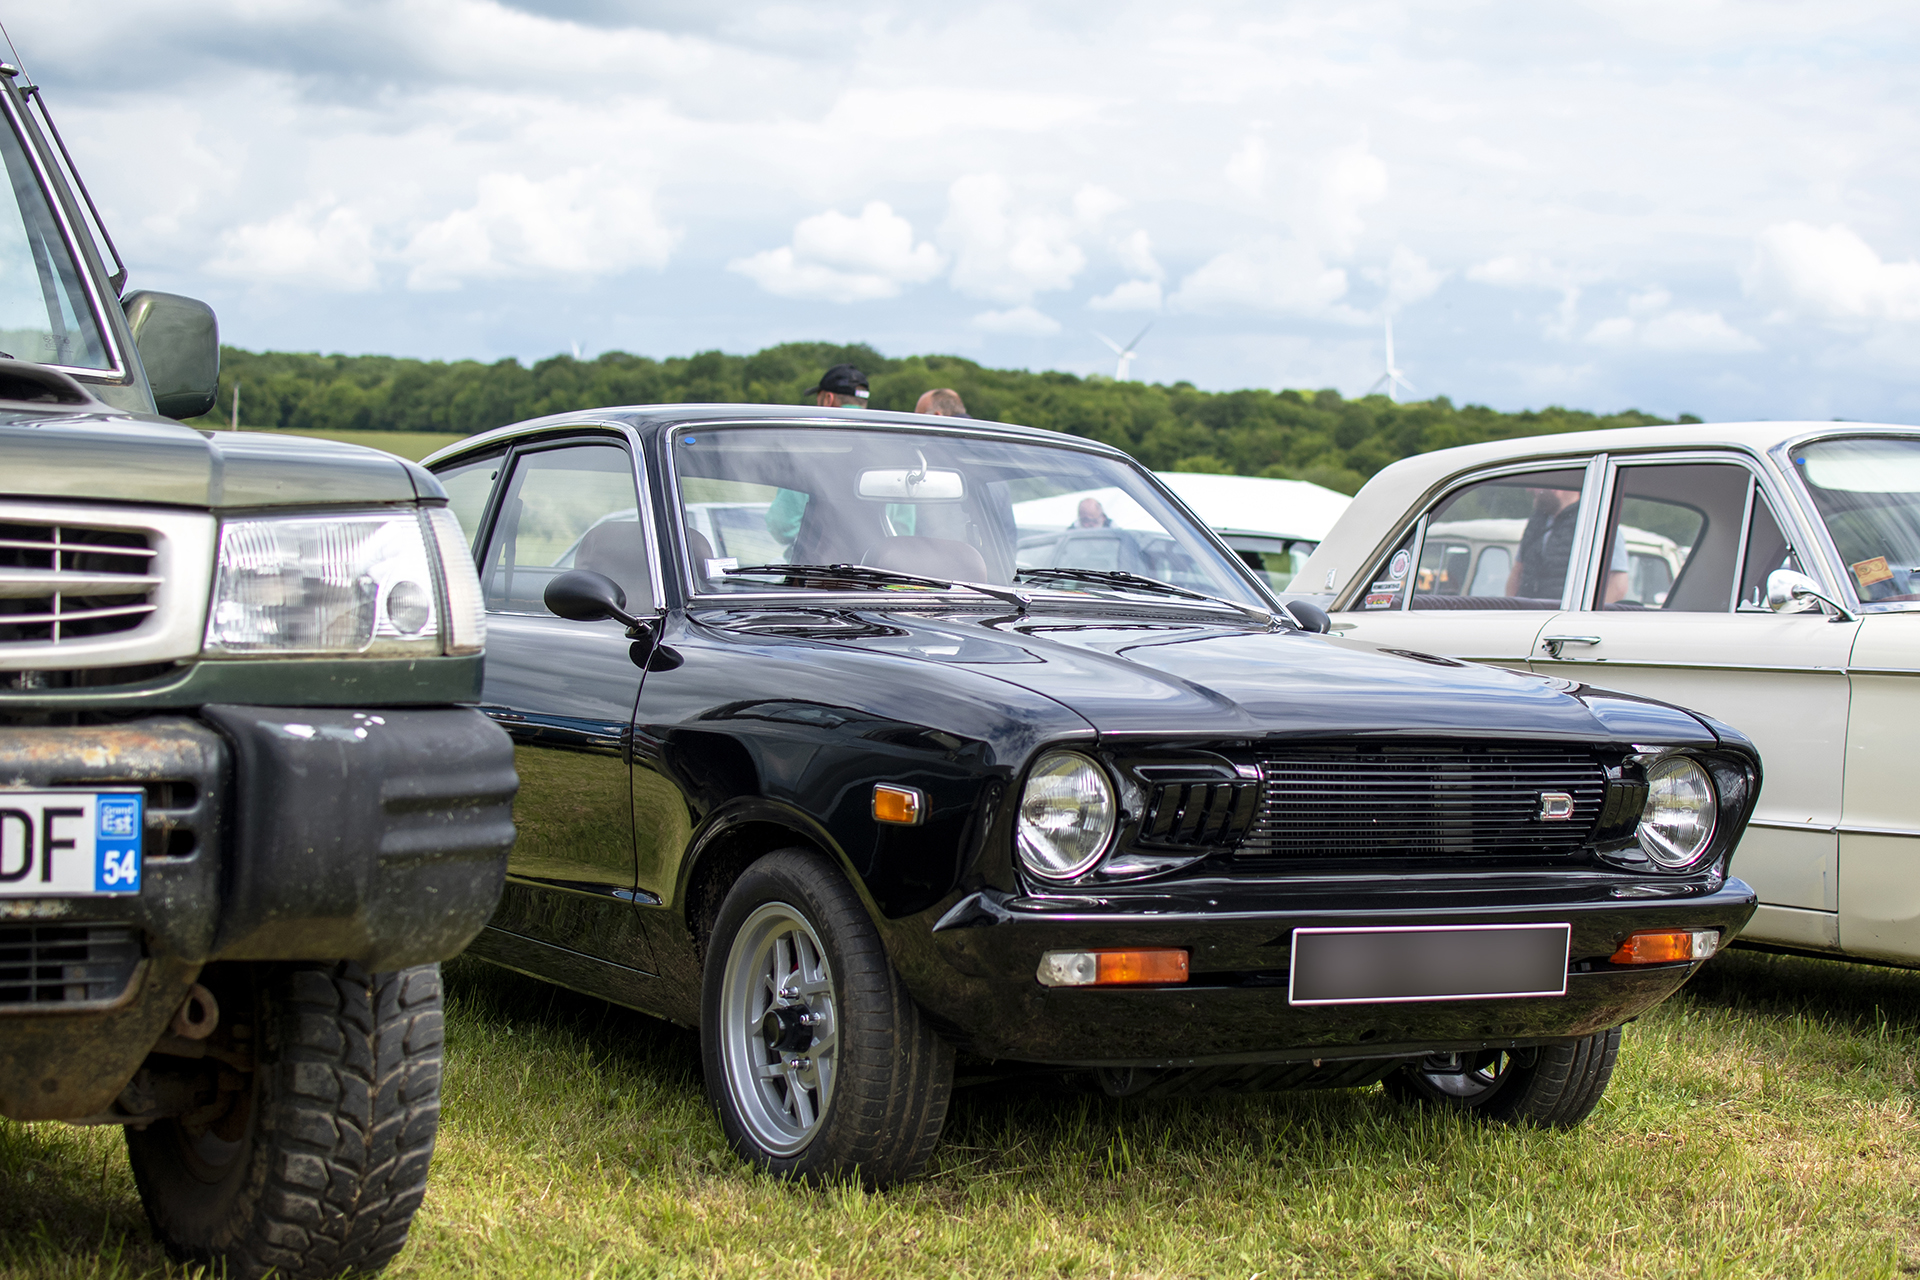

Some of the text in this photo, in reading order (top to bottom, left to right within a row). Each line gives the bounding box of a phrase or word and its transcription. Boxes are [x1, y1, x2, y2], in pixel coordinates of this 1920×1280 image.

[102, 815, 132, 832] Est
[0, 807, 84, 882] DF
[103, 850, 137, 885] 54
